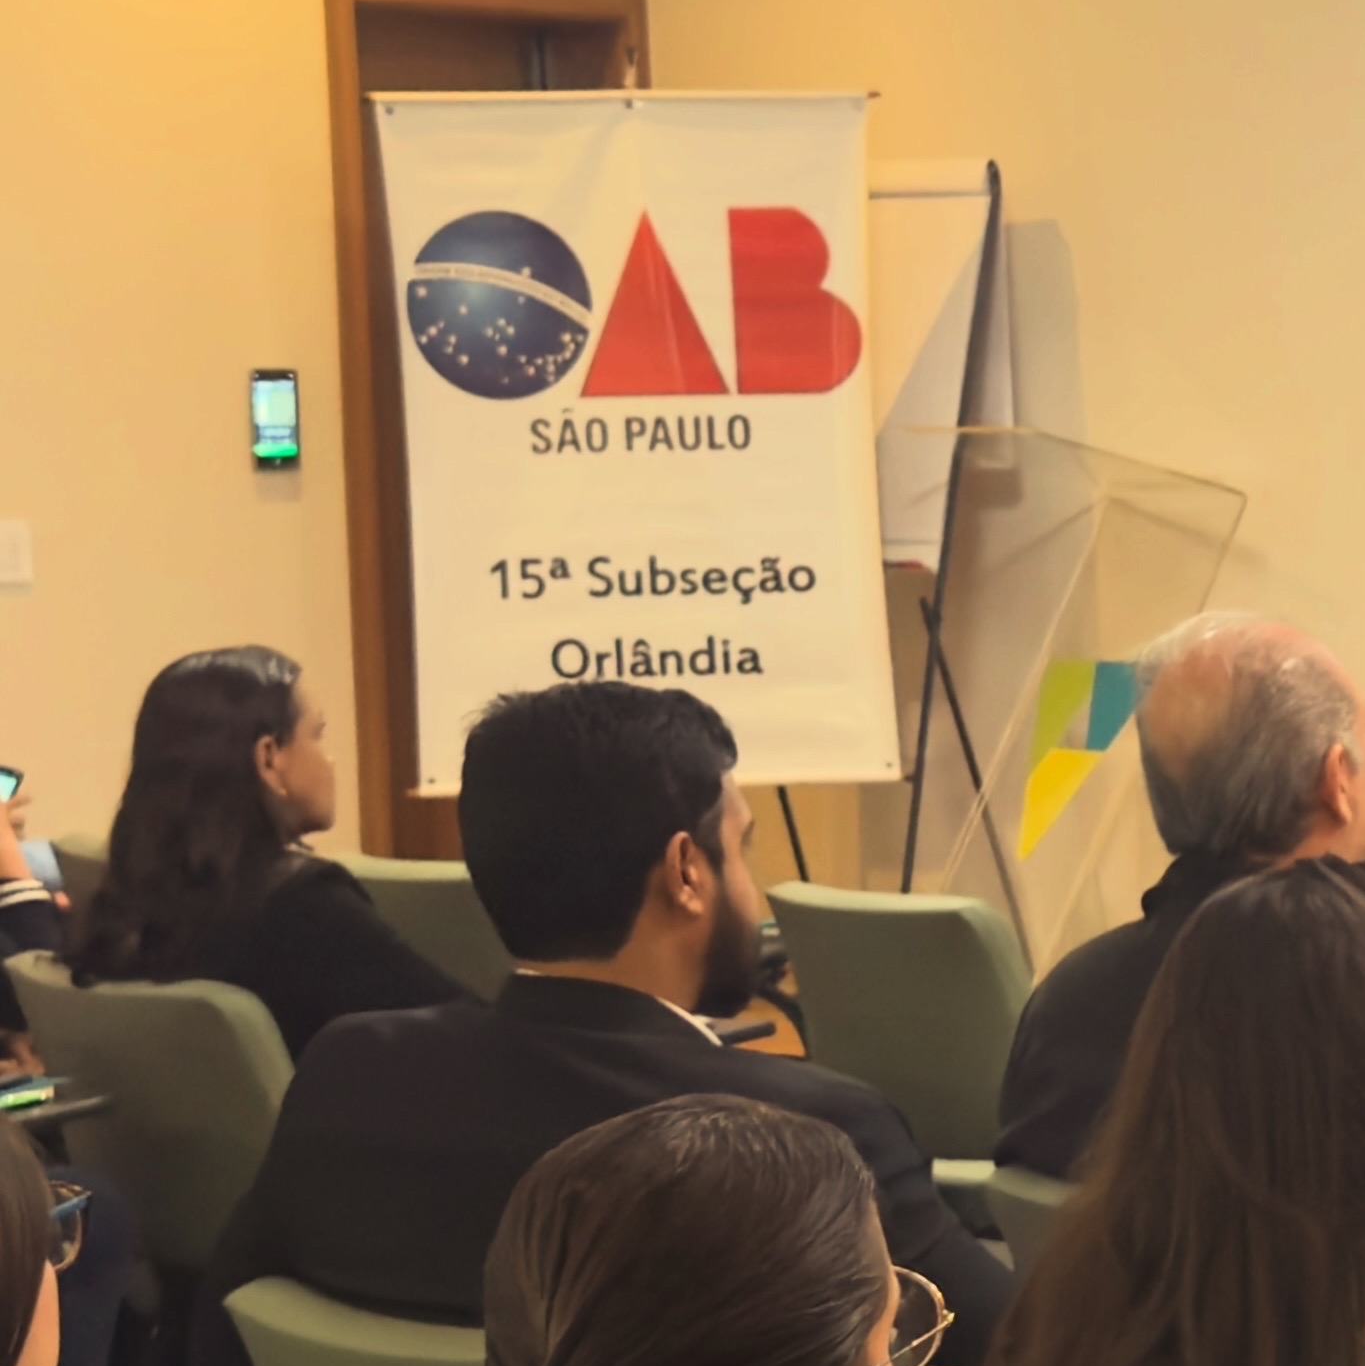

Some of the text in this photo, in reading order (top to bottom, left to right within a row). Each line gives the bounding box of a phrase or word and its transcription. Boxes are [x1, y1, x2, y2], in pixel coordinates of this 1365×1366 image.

[530, 407, 752, 455] SÃO PAULO
[489, 554, 817, 605] 15ª Subseção
[550, 634, 764, 680] Orlândia
